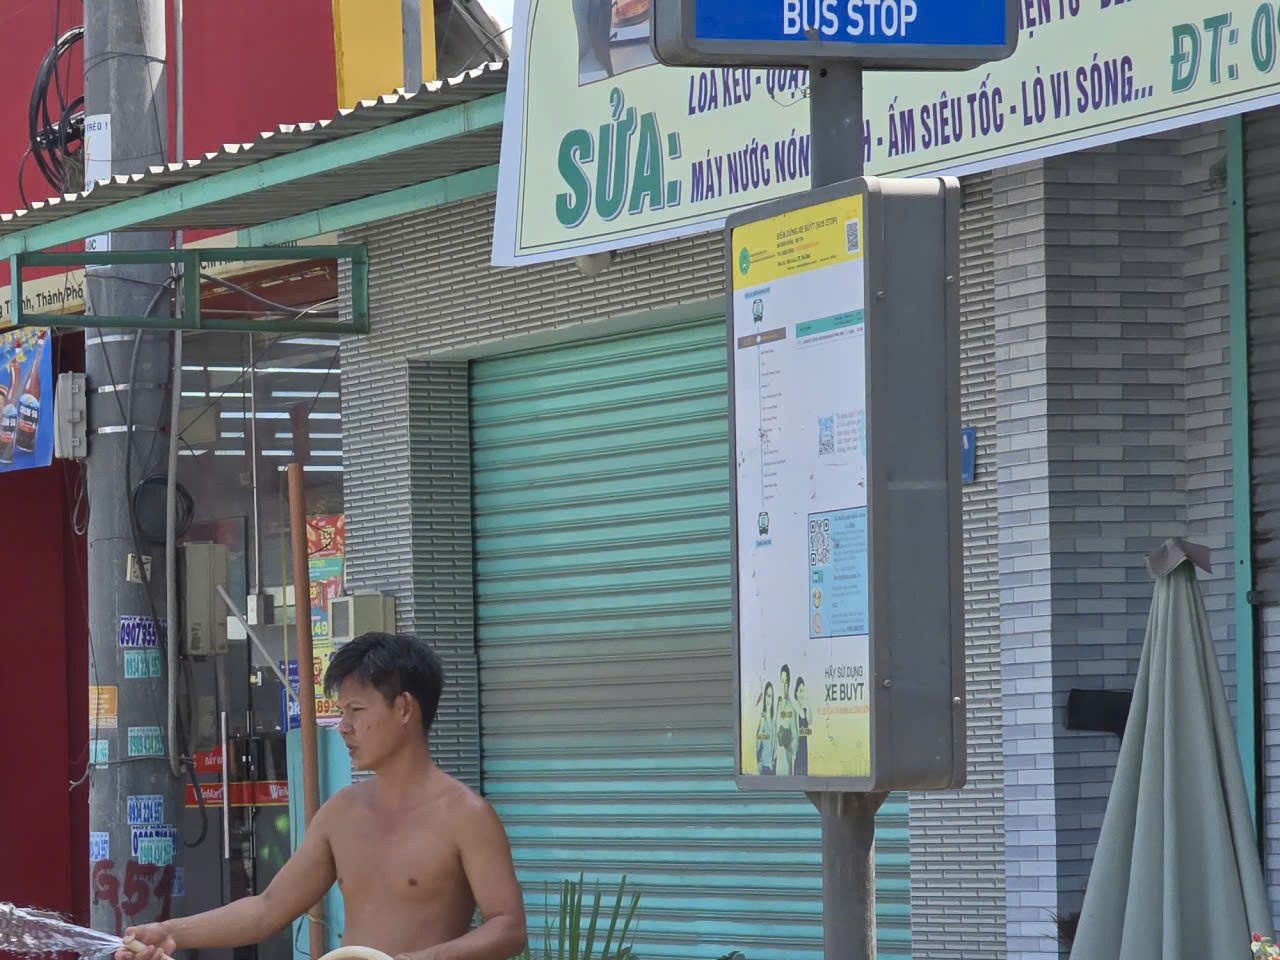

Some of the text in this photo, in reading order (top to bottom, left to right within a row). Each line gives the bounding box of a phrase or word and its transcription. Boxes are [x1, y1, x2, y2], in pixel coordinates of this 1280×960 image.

[783, 0, 918, 36] BUS STOP
[1170, 2, 1280, 94] ĐT: 0
[688, 69, 718, 116] LOA
[887, 96, 916, 158] ẤM
[921, 90, 963, 156] SIÊU
[967, 73, 1005, 140] TỐC
[1021, 66, 1046, 127] LÒ
[1050, 61, 1070, 122] VI
[1076, 52, 1154, 114] SÓNG...
[556, 87, 682, 229] SỬA:
[690, 149, 723, 203] MÁY
[727, 138, 770, 194] NƯỚC
[775, 128, 811, 184] NÓN
[36, 289, 65, 308] Thành
[66, 280, 85, 300] Phố
[825, 678, 865, 702] XE BUÝT
